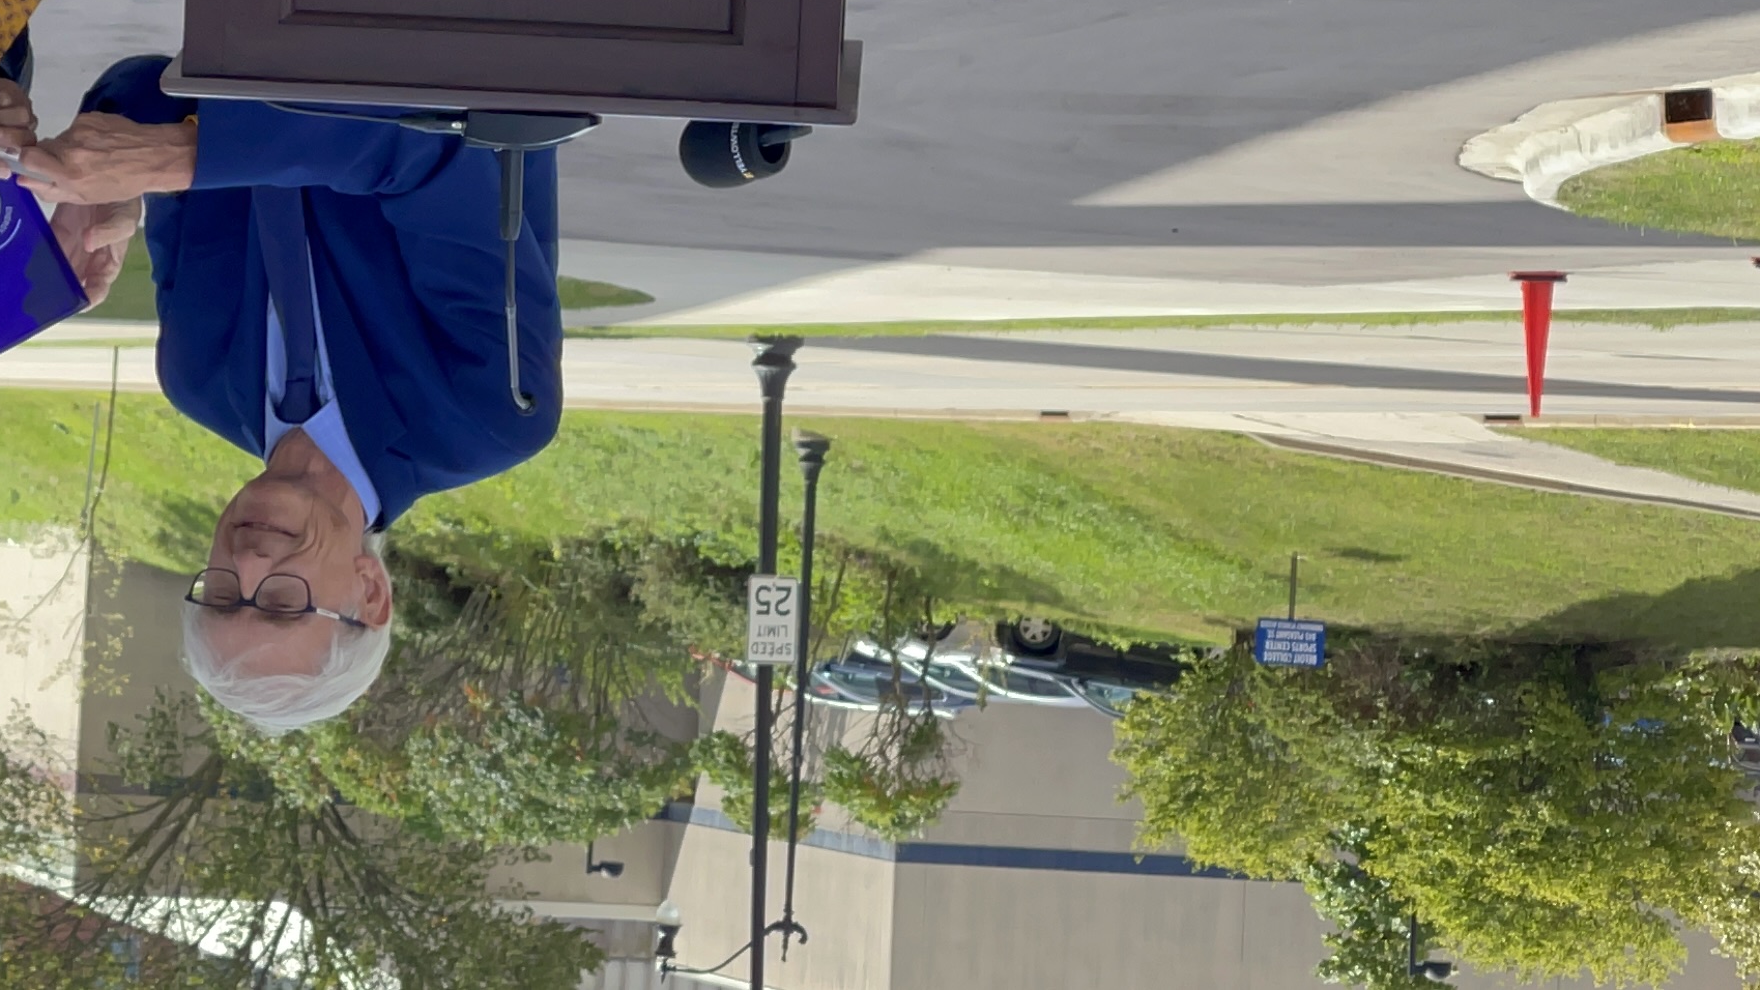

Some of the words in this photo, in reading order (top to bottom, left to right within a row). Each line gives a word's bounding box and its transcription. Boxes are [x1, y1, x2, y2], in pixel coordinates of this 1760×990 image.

[730, 122, 748, 173] YELLOWTE
[755, 585, 792, 616] 25
[757, 625, 788, 638] LIMIT
[751, 642, 792, 656] SPEED
[1265, 640, 1290, 650] CENTER
[1292, 641, 1317, 653] SPORTS
[1263, 651, 1292, 663] COLLEGE
[1293, 654, 1317, 665] BELOIT
